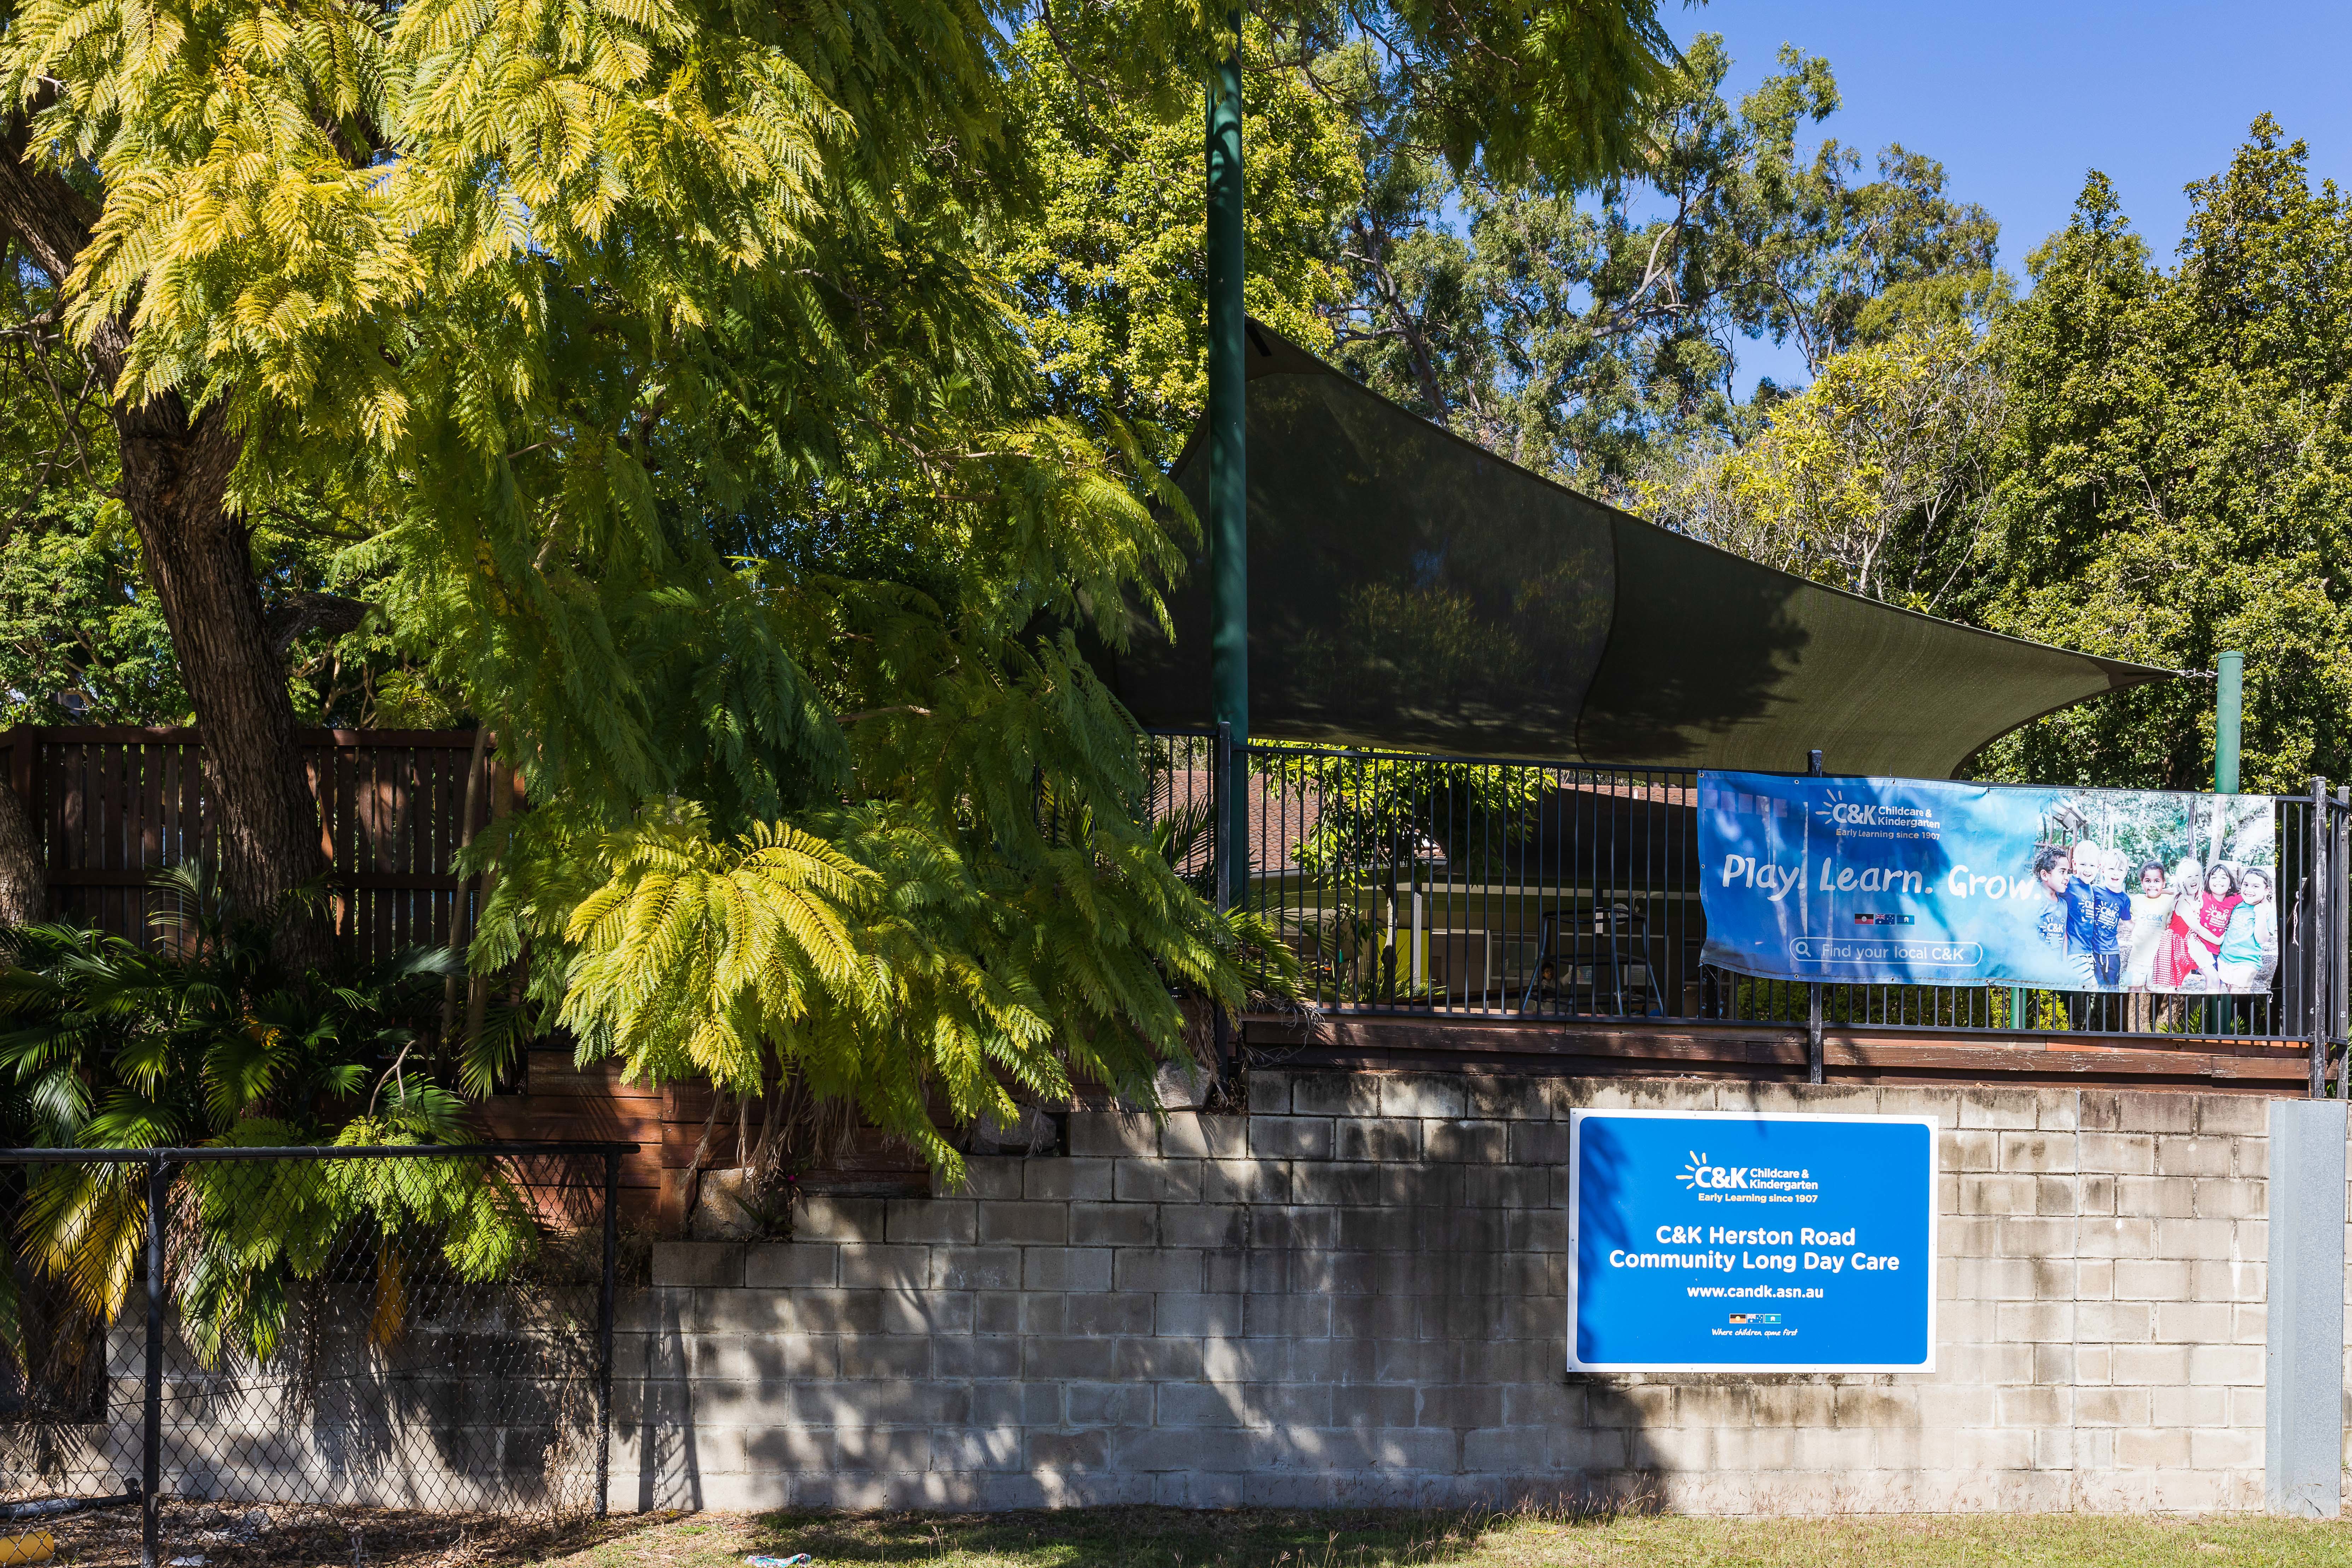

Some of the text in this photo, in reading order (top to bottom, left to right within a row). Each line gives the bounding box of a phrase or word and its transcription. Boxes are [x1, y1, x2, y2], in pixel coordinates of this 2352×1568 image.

[1833, 803, 1877, 825] C&K
[1878, 806, 1932, 818] Childcare &
[1878, 817, 1940, 829] Kindergarten
[1836, 829, 1857, 837] Early
[1858, 829, 1894, 839] Learning
[1922, 832, 1940, 840] 1907
[1722, 854, 2042, 902] Play. Learn. Grow.
[2100, 906, 2117, 919] C&K
[2211, 910, 2227, 921] C&K
[2047, 923, 2064, 933] C&K
[1822, 944, 1964, 961] Find your local C&K
[1695, 1166, 1748, 1189] C&K
[1750, 1168, 1809, 1178] Childcare &
[1750, 1179, 1818, 1191] Kindergarten
[1698, 1193, 1818, 1203] Early Learning since 1907
[1656, 1225, 1855, 1246] C&K Herston Road
[1609, 1249, 1900, 1273] Community Long Day Care
[1687, 1284, 1824, 1299] www.candk.asn.au
[1711, 1328, 1733, 1336] Where
[1782, 1328, 1798, 1336] first
